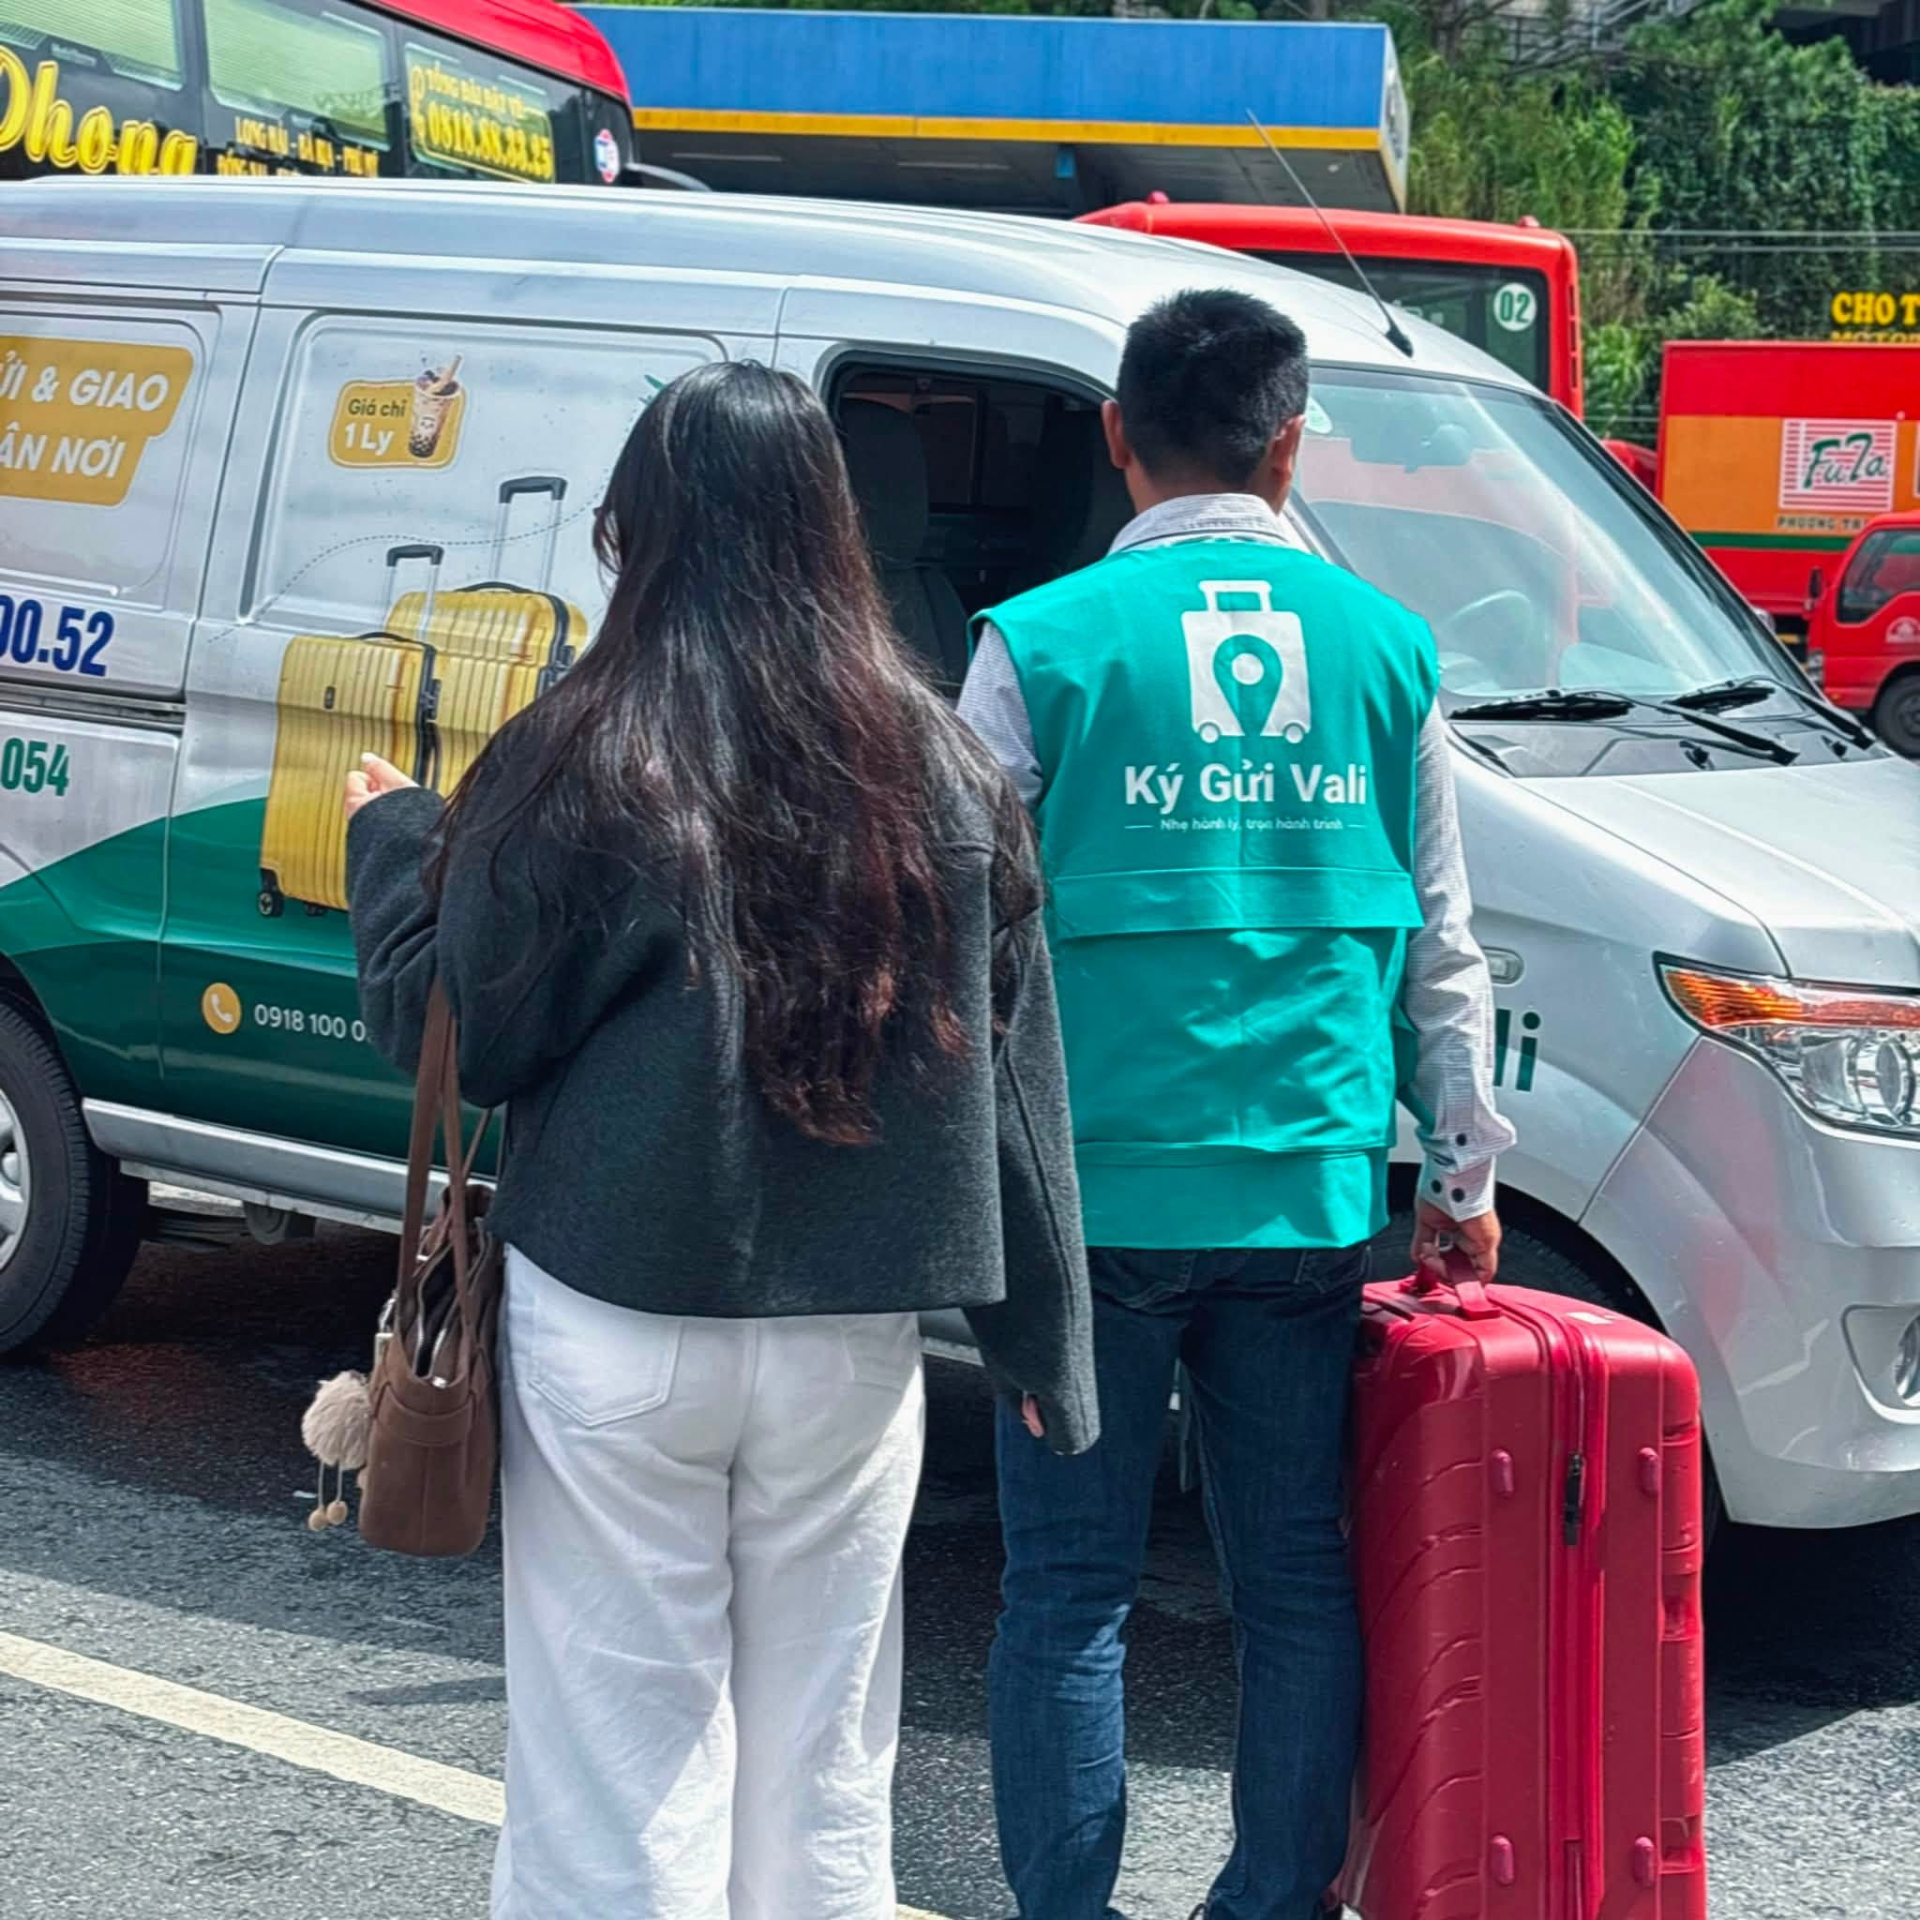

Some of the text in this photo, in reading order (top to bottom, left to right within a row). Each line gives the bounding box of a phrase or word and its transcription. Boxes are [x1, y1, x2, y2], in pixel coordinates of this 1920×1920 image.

[1500, 290, 1530, 324] 02
[1831, 291, 1920, 326] CHO T
[0, 350, 169, 412] ỬI & GIAO
[348, 398, 376, 417] Giá
[0, 420, 127, 478] ÂN NƠI
[344, 421, 395, 456] 1 Ly
[1, 737, 70, 797] 054
[1124, 758, 1368, 815] Ký Gửi Vali
[254, 1003, 369, 1042] 0918 100 0
[1493, 1008, 1541, 1093] li
